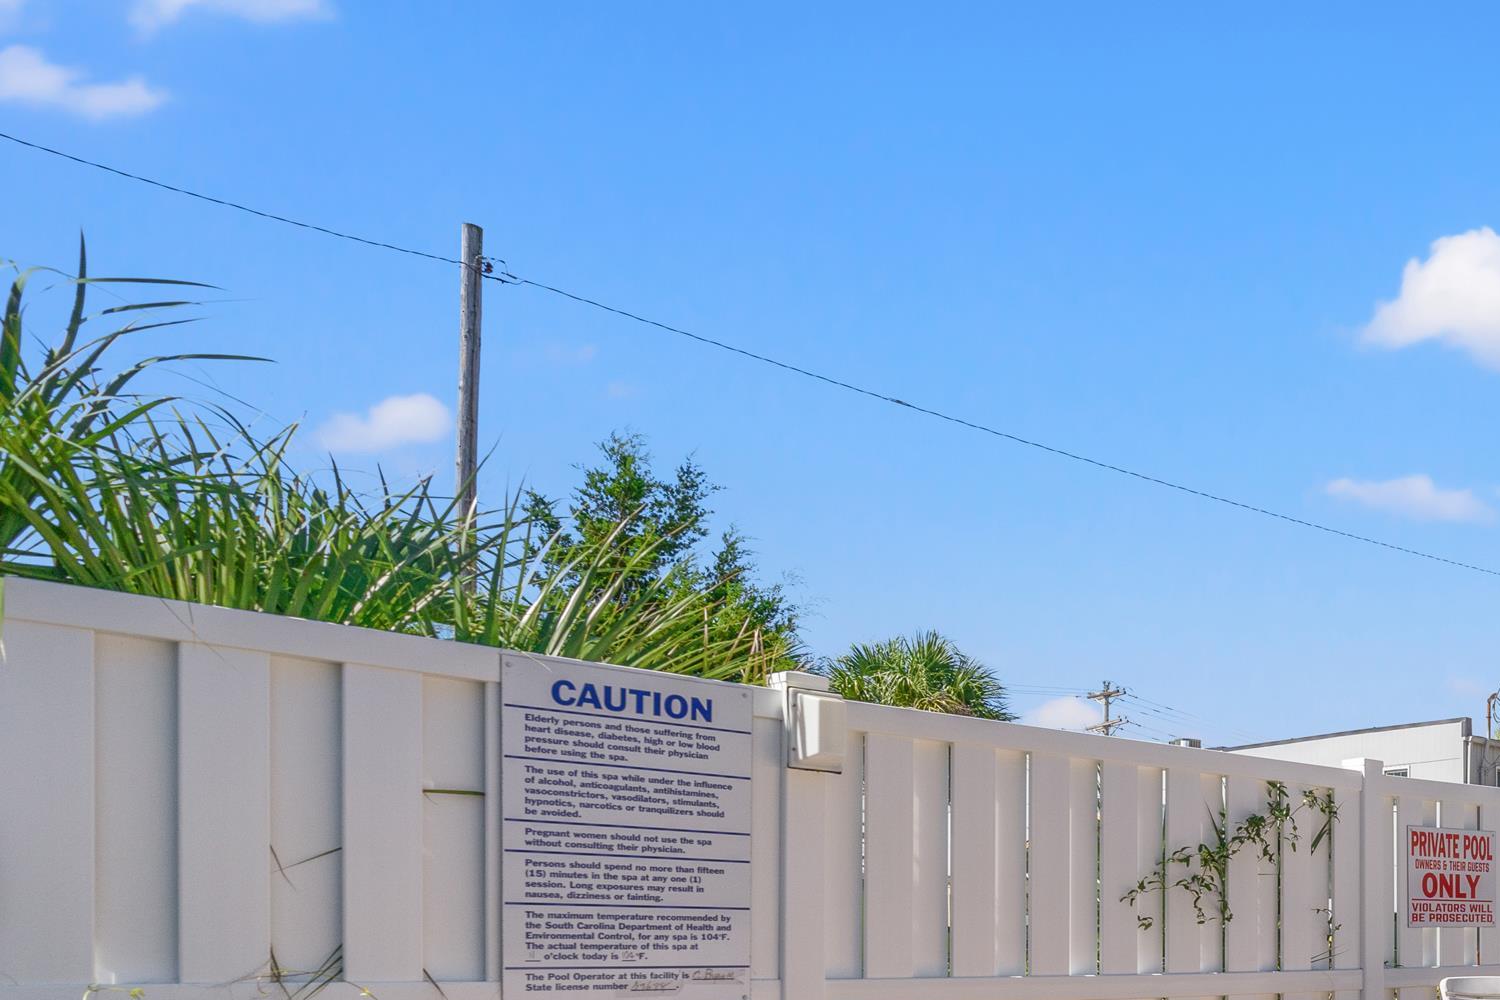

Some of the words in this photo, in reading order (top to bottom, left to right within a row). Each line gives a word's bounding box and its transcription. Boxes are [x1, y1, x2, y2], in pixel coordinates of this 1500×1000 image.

[551, 680, 713, 722] CAUTION
[525, 713, 560, 727] Elderly
[563, 719, 602, 729] persons
[604, 723, 622, 731] and
[625, 724, 651, 735] those
[653, 728, 693, 741] suffering
[695, 732, 716, 742] from
[524, 765, 544, 774] The
[567, 769, 578, 777] of
[581, 770, 599, 779] this
[602, 773, 619, 782] spa
[621, 774, 645, 783] while
[648, 777, 675, 786] under
[677, 778, 691, 787] the
[694, 780, 733, 791] influence
[524, 776, 535, 784] of
[538, 777, 576, 789] alcohol,
[579, 781, 650, 795] anticoagulants,
[653, 787, 719, 800] antihistamines,
[525, 788, 608, 801] vasoconstrictors,
[611, 794, 669, 806] vasodilators,
[672, 797, 719, 810] stimulants,
[524, 796, 576, 809] hypnotics,
[579, 802, 623, 811] narcotics
[638, 804, 694, 816] tranquilizers
[696, 809, 725, 819] should
[525, 827, 570, 839] Pregnant
[573, 832, 607, 840] women
[610, 832, 641, 842] should
[643, 835, 659, 843] not
[680, 836, 694, 845] the
[697, 839, 712, 848] spa
[525, 838, 562, 848] without
[564, 841, 614, 852] consulting
[617, 842, 639, 852] their
[641, 844, 685, 855] physician.
[1411, 831, 1459, 857] PRIVATE
[1463, 835, 1492, 861] POOL
[525, 859, 566, 869] Persons
[569, 861, 601, 870] should
[604, 863, 632, 873] spend
[675, 865, 695, 874] than
[697, 866, 725, 875] fifteen
[1415, 859, 1441, 871] OWNERS
[1442, 861, 1447, 871] &
[1449, 861, 1467, 872] THEIR
[1467, 862, 1490, 873] GUESTS
[525, 869, 546, 879] (15)
[549, 870, 589, 879] minutes
[591, 871, 600, 880] in
[603, 872, 618, 881] the
[621, 874, 638, 883] spa
[640, 873, 650, 882] at
[652, 876, 668, 885] any
[689, 875, 701, 884] (1)
[525, 880, 566, 889] session.
[569, 881, 594, 892] Long
[596, 884, 644, 893] exposures
[647, 885, 666, 894] may
[668, 885, 694, 893] result
[696, 885, 704, 893] in
[1422, 872, 1481, 899] ONLY
[525, 892, 563, 900] nausea,
[566, 891, 611, 900] dizziness
[627, 893, 664, 904] fainting.
[1412, 902, 1466, 913] VIOLATORS
[1469, 903, 1492, 913] WILL
[525, 910, 544, 919] The
[547, 911, 594, 920] maximum
[597, 912, 654, 923] temperature
[656, 914, 718, 922] recommended
[720, 914, 731, 925] by
[1412, 912, 1425, 922] BE
[525, 921, 542, 929] the
[545, 921, 574, 930] South
[576, 922, 616, 930] Carolina
[618, 922, 672, 933] Department
[674, 923, 684, 931] of
[686, 923, 714, 931] Health
[716, 924, 732, 932] and
[525, 931, 595, 940] Environmental
[597, 932, 635, 941] Control,
[638, 932, 651, 941] for
[654, 934, 669, 943] any
[672, 934, 688, 943] spa
[690, 933, 698, 941] is
[525, 942, 544, 950] The
[547, 942, 577, 950] actual
[579, 942, 638, 952] temperature
[640, 942, 650, 950] of
[652, 942, 669, 950] this
[672, 944, 687, 953] spa
[690, 942, 698, 951] at
[543, 952, 579, 960] o'clock
[582, 952, 608, 962] today
[611, 952, 619, 960] is
[525, 973, 545, 981] The
[547, 972, 570, 981] Pool
[573, 972, 616, 983] Operator
[618, 972, 627, 980] at
[630, 971, 647, 980] this
[650, 971, 679, 981] facility
[682, 971, 690, 980] is
[526, 983, 552, 992] State
[555, 983, 590, 991] license
[592, 982, 629, 991] number
